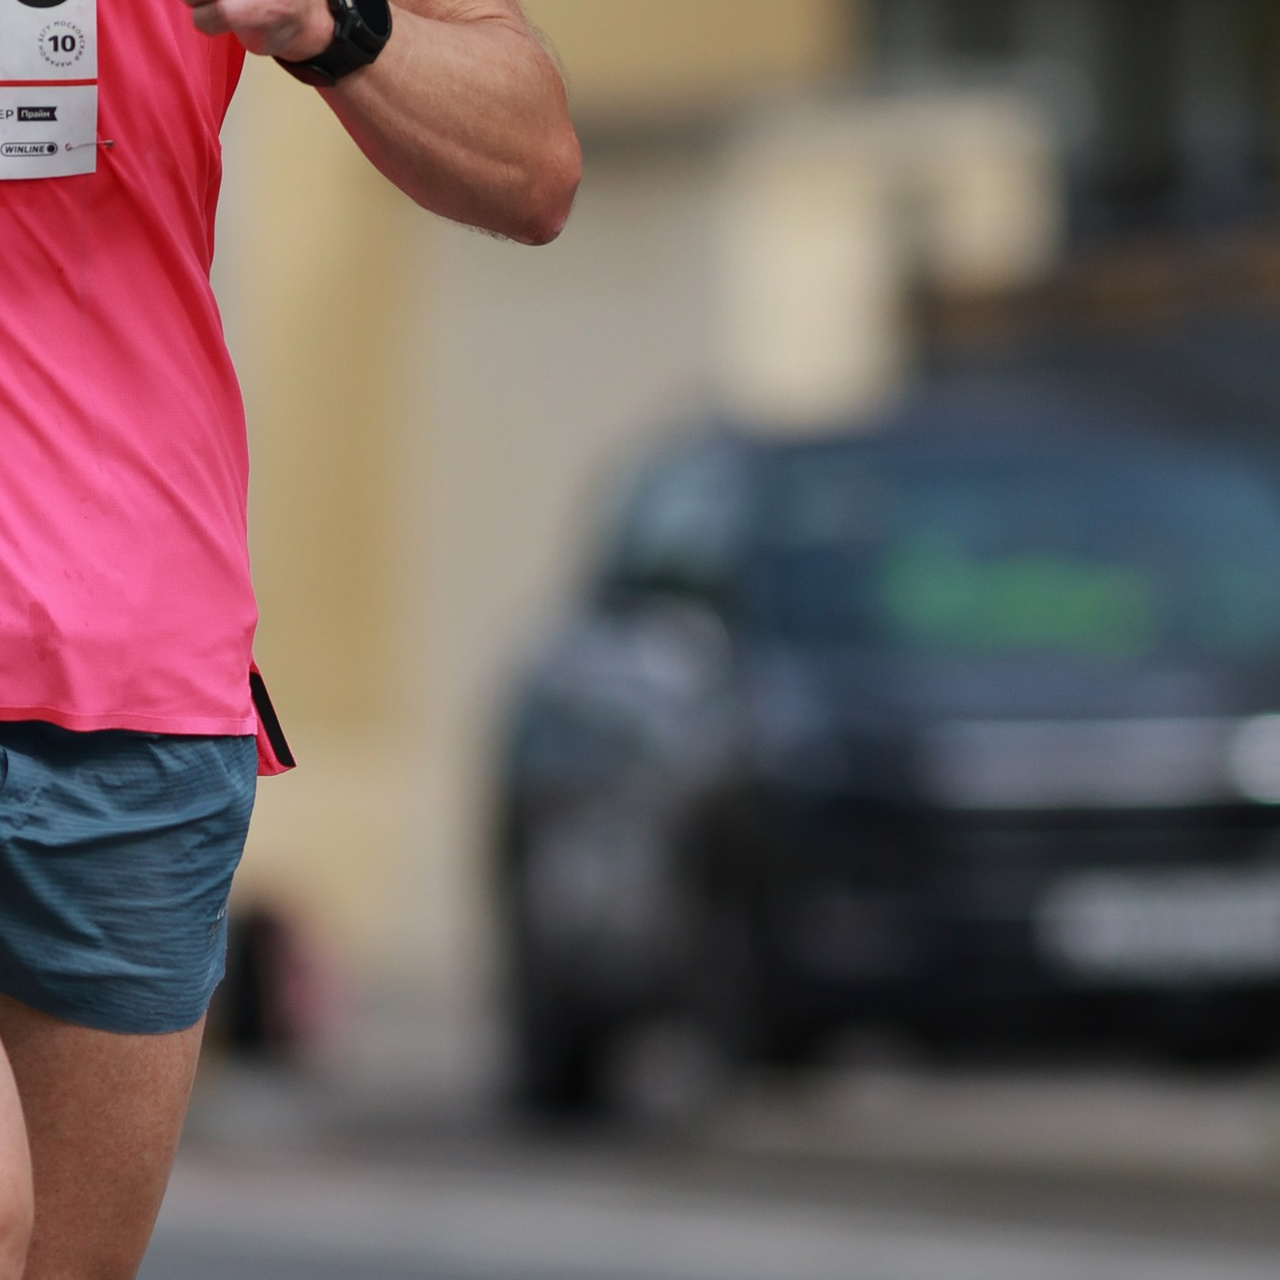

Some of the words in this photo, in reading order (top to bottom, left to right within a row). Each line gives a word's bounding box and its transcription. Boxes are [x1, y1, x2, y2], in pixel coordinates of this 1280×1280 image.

[47, 35, 76, 52] 10
[20, 109, 50, 119] Прайм
[4, 146, 45, 154] WINLINE
